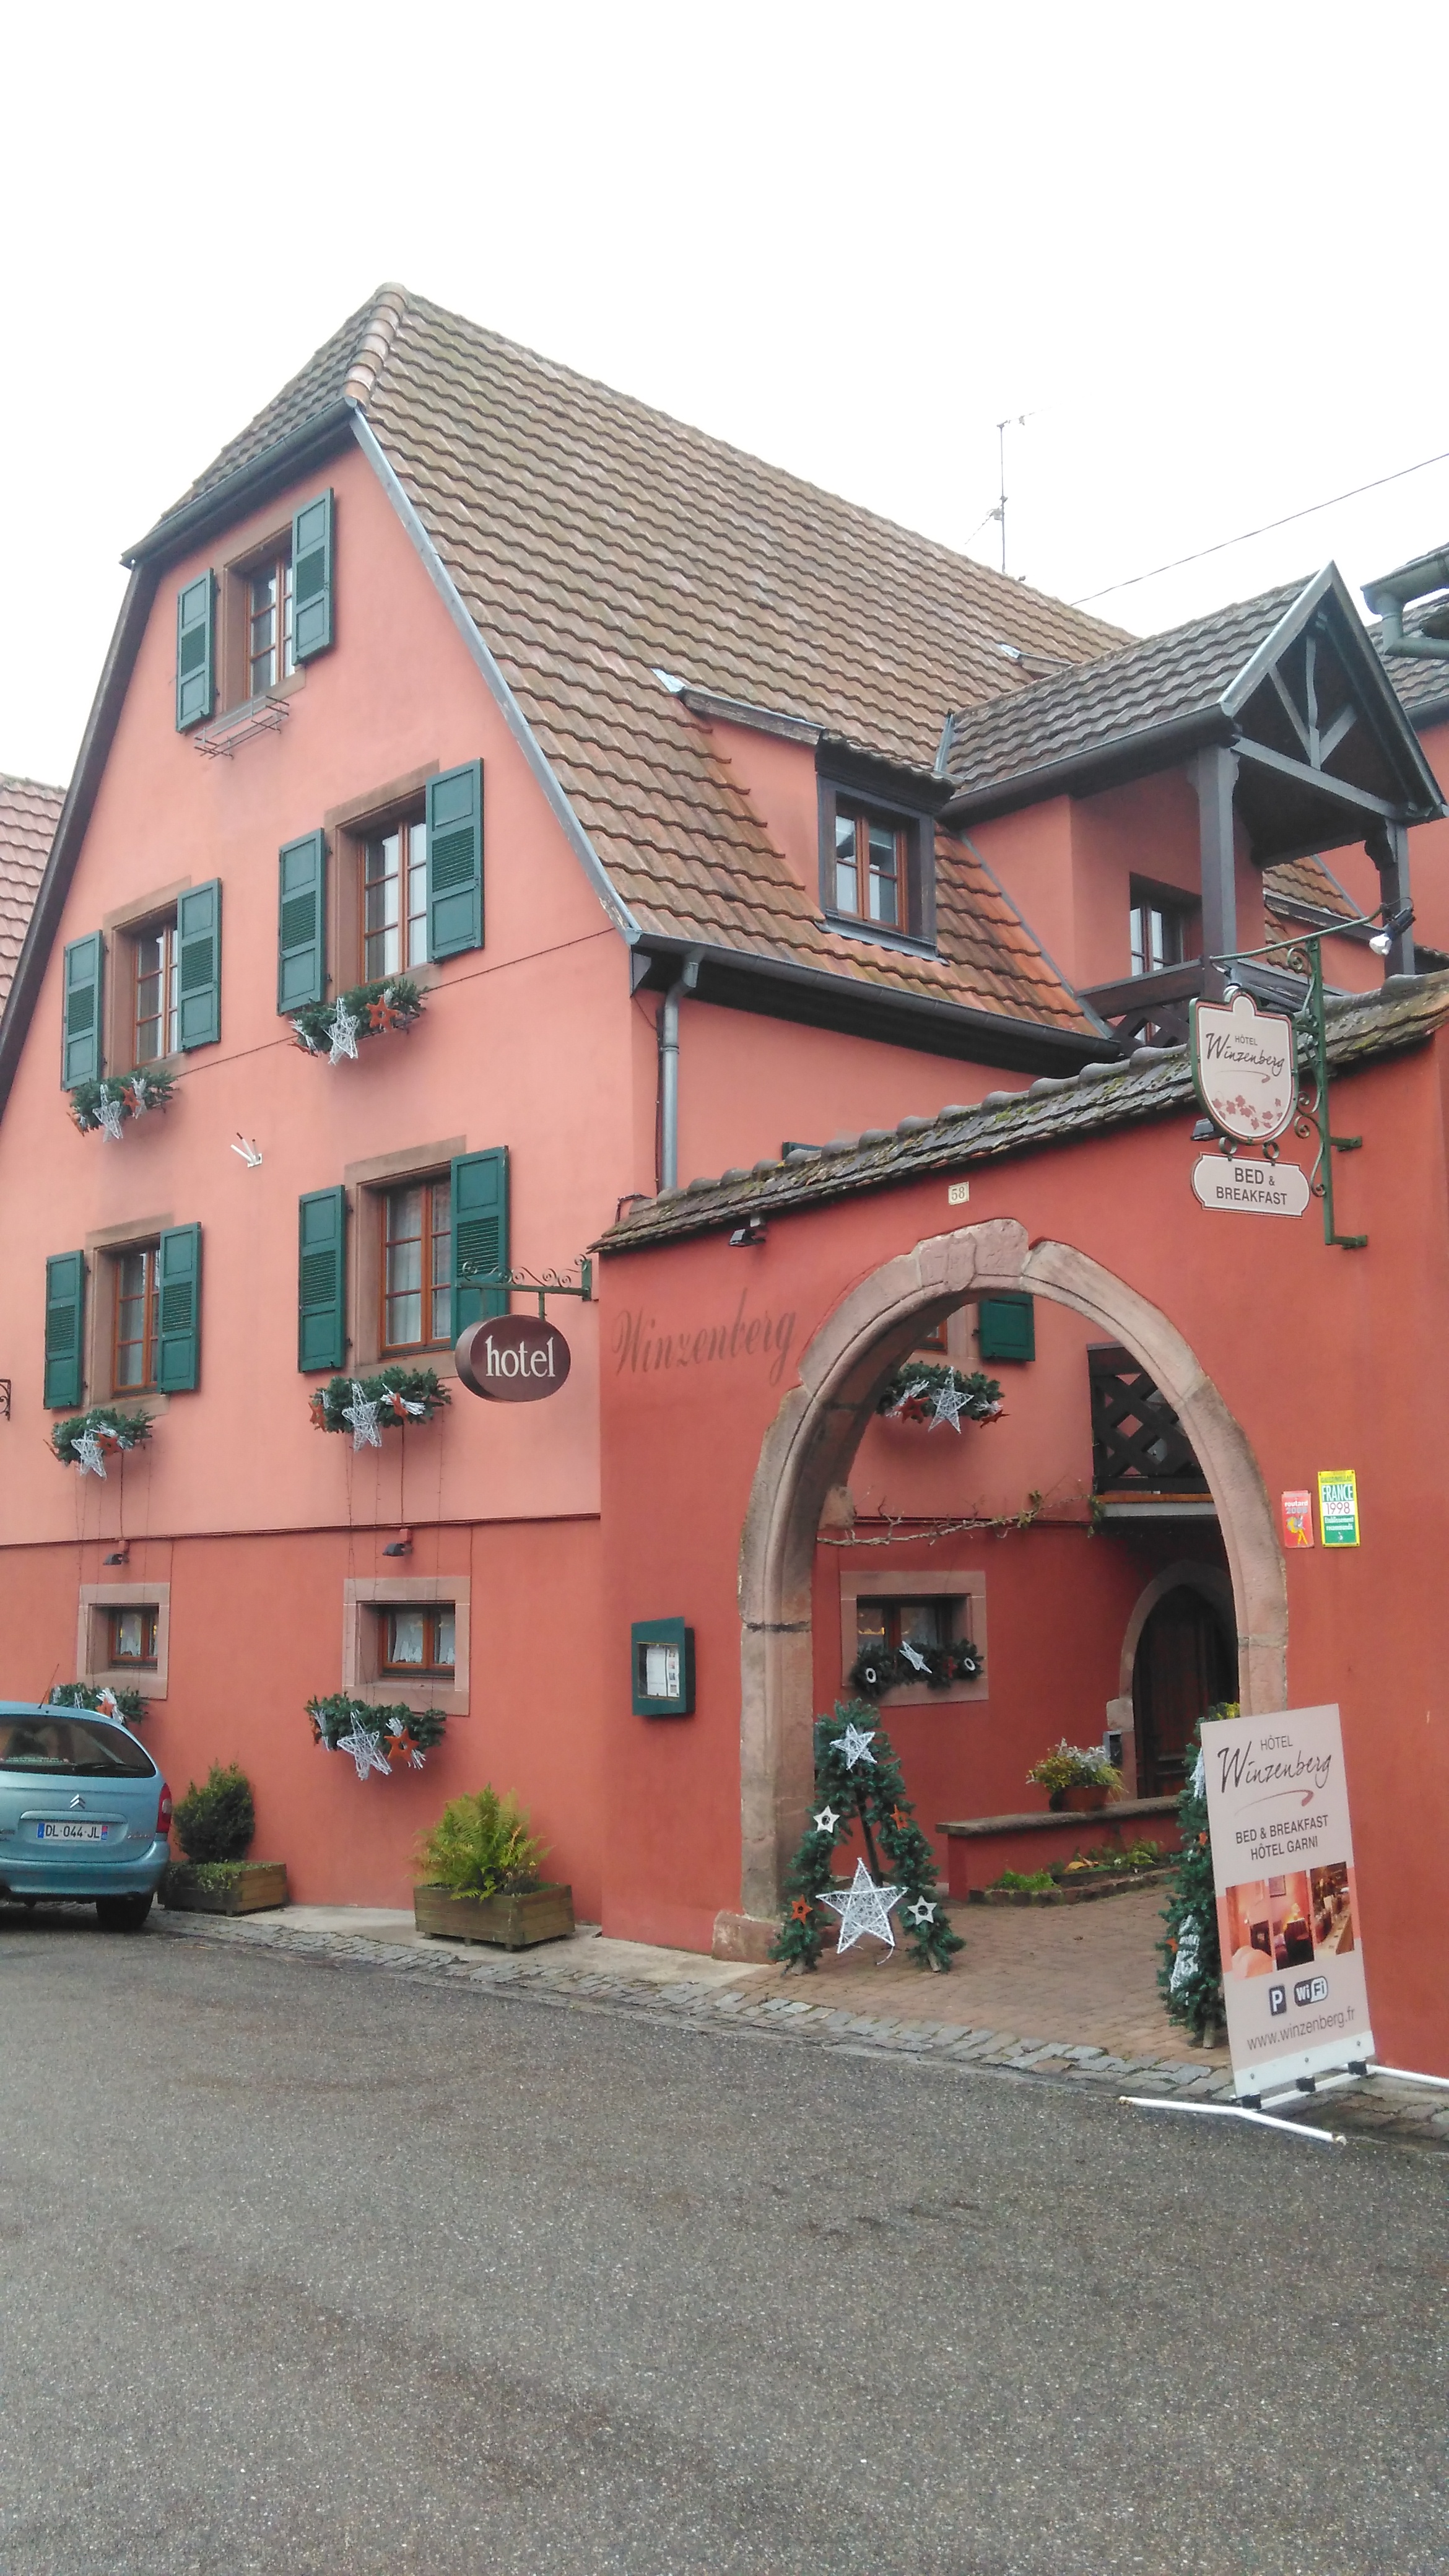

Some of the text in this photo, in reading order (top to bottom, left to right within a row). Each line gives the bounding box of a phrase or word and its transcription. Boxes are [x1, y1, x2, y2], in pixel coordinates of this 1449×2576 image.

[1235, 1034, 1258, 1046] HÔTEL
[1206, 1033, 1285, 1077] Winzenberg
[1235, 1167, 1276, 1186] BED &
[951, 1186, 965, 1201] 58
[1216, 1186, 1287, 1205] BREAKFAST
[612, 1287, 796, 1387] Winzenberg
[485, 1335, 556, 1378] hotel
[1322, 1484, 1354, 1502] FRANCE
[1326, 1502, 1351, 1515] 1998
[1261, 1735, 1293, 1751] HÔTEL
[1217, 1741, 1331, 1793] Winzenberg
[1235, 1815, 1328, 1844] BED & BREAKFAST
[1251, 1835, 1318, 1860] HÔTEL GARNI
[1271, 1981, 1325, 2012] P WiFi
[1247, 2006, 1355, 2050] www.winzenberg.fr
